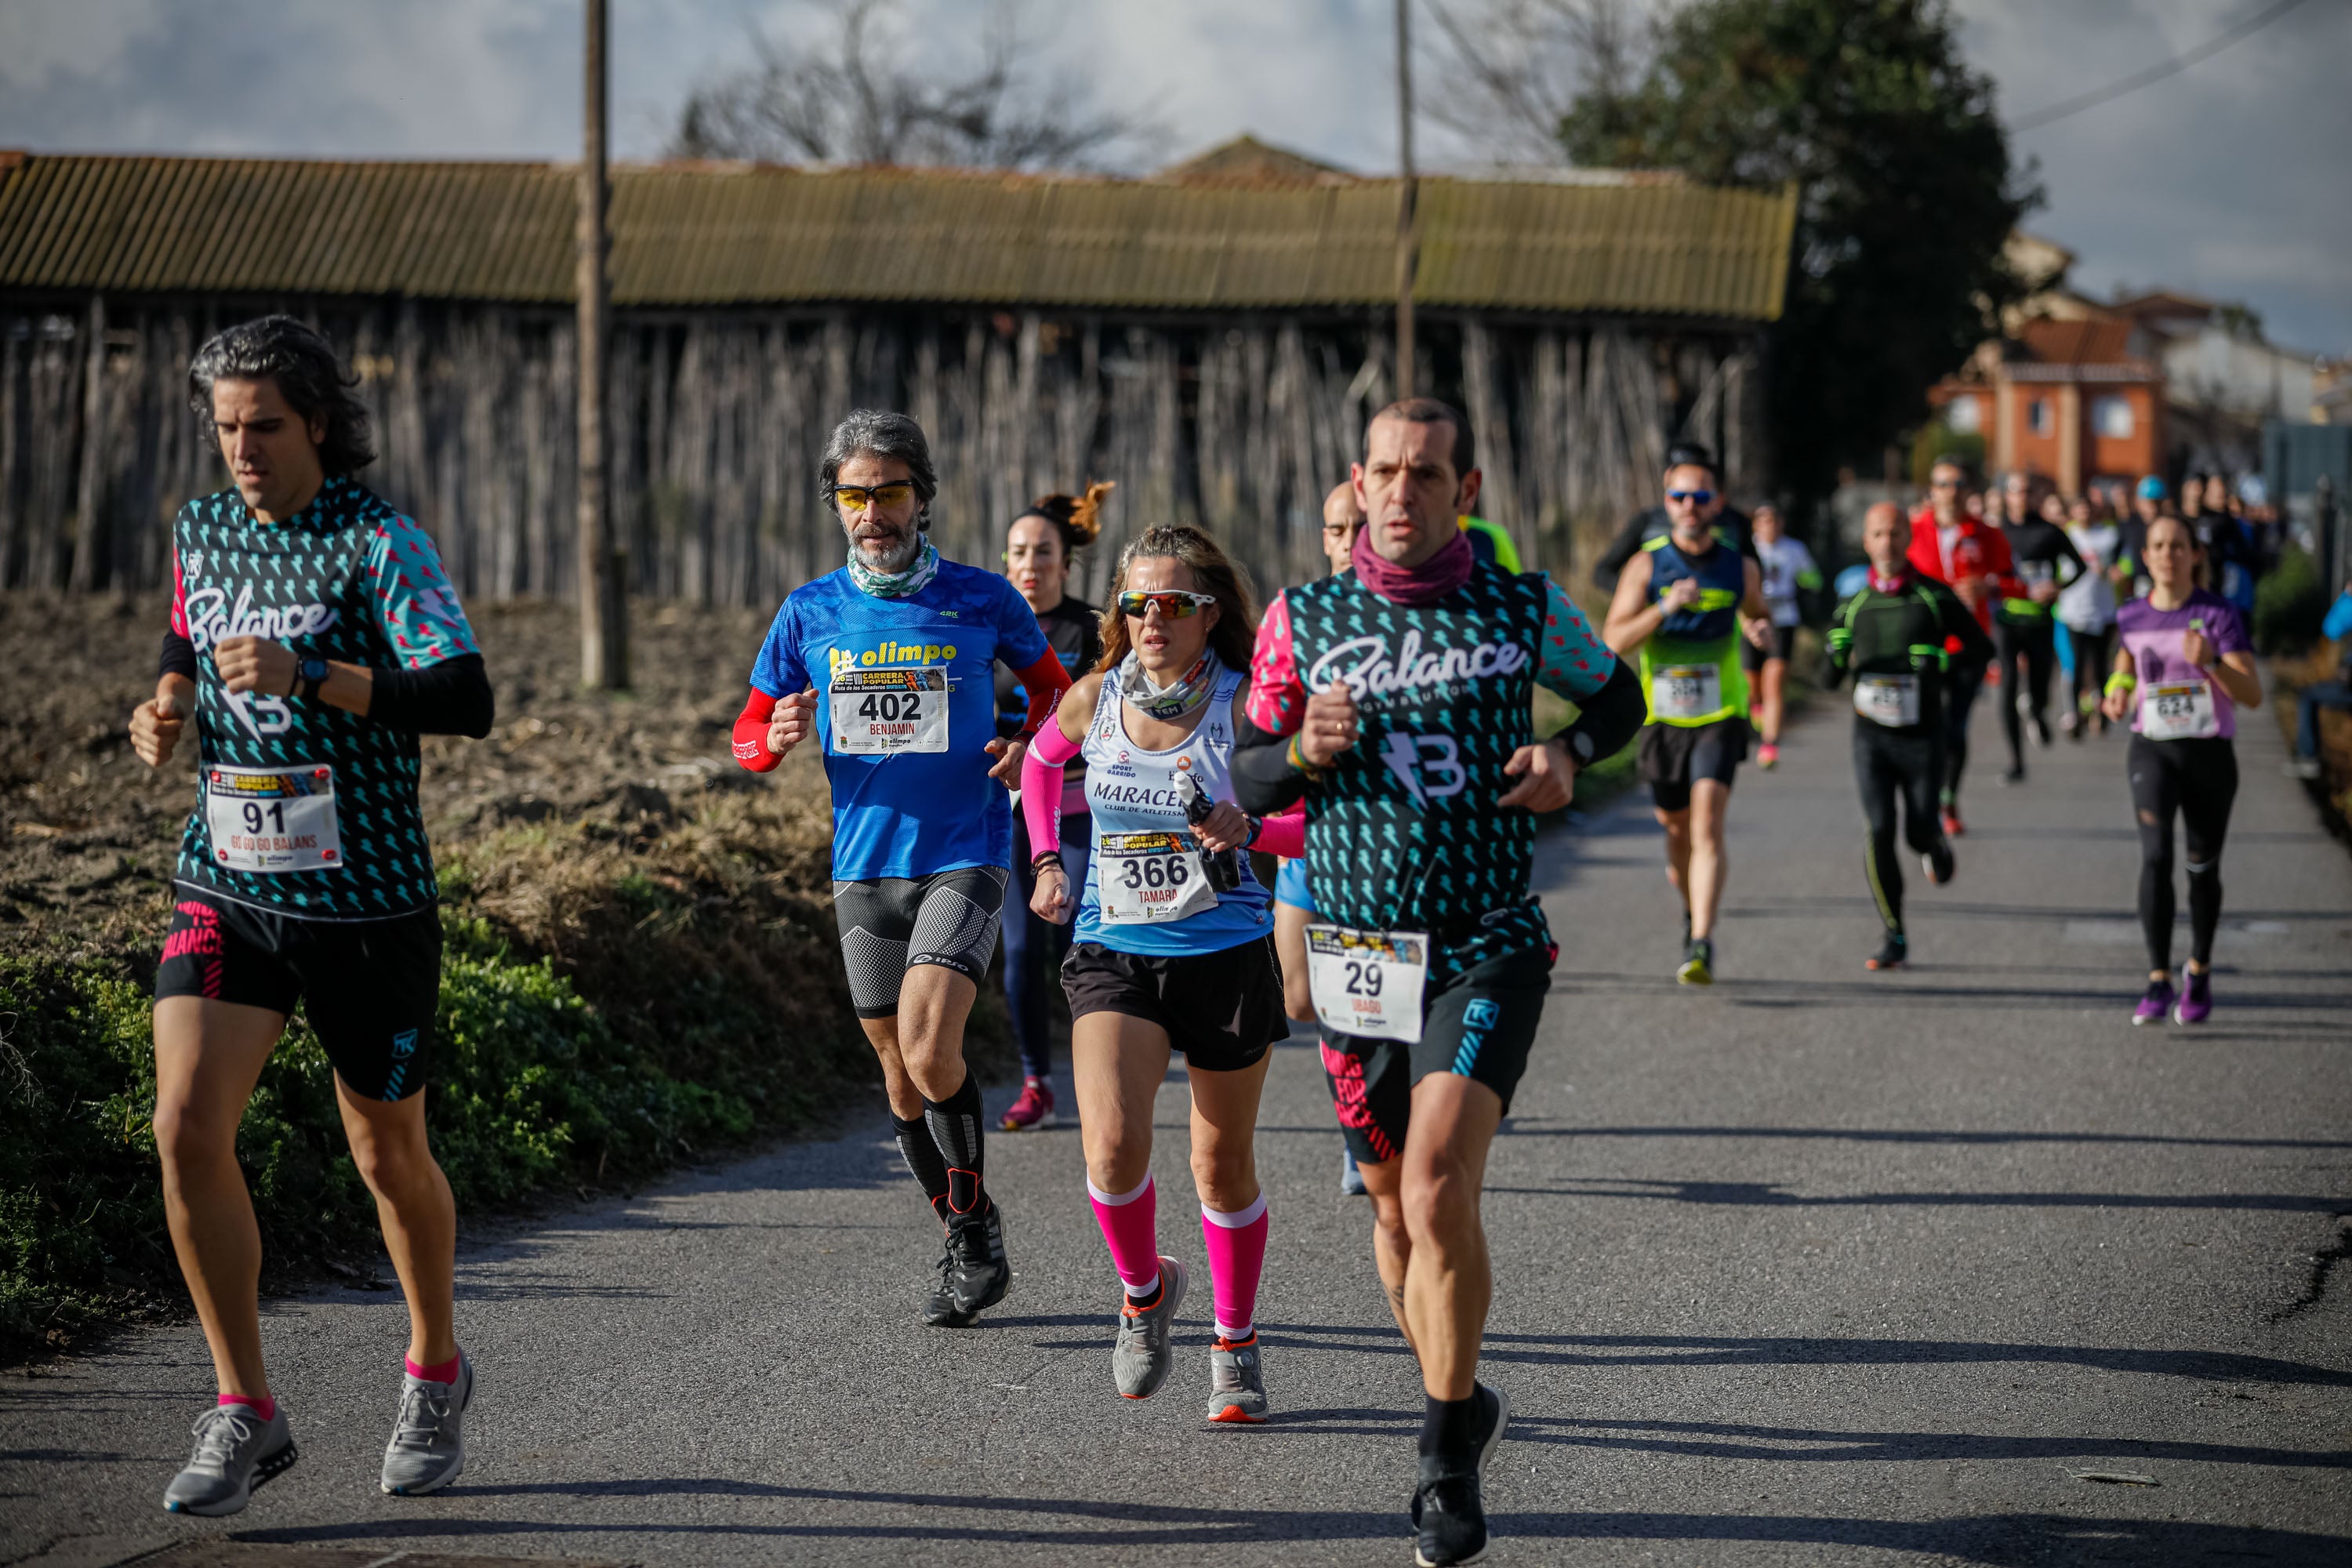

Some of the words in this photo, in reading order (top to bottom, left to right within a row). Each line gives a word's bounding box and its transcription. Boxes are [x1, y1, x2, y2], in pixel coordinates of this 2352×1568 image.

[184, 586, 337, 652] Balance
[862, 641, 957, 666] olimpo
[1309, 629, 1527, 702] Balance
[858, 693, 922, 721] 402
[869, 723, 915, 735] BENJAMIN
[1106, 769, 1136, 778] GARRIDO
[1094, 782, 1183, 807] MARACE
[243, 801, 285, 834] 91
[1142, 808, 1185, 817] ATLETISM
[256, 837, 270, 851] GO
[273, 834, 318, 851] BALANS
[1123, 834, 1167, 843] CARRERA
[1122, 855, 1189, 889] 366
[1138, 889, 1178, 903] TAMARA
[1345, 961, 1383, 996] 29
